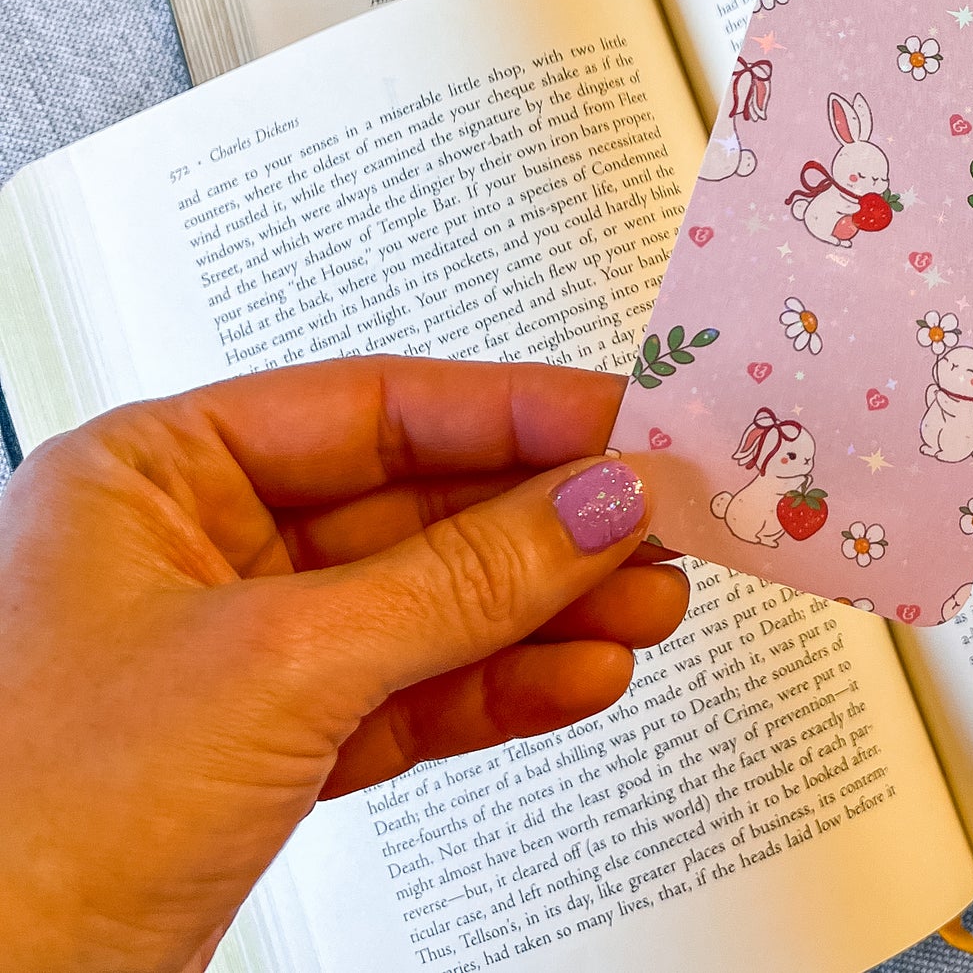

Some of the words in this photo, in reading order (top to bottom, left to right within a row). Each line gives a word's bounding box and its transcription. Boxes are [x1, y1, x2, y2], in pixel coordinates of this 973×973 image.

[169, 165, 191, 185] 572
[209, 136, 252, 163] Charles
[254, 116, 300, 145] Dickens
[177, 188, 201, 212] and
[207, 177, 240, 199] came
[244, 168, 259, 182] to
[264, 153, 293, 179] your
[297, 134, 340, 159] senses
[344, 125, 359, 140] in
[365, 120, 373, 131] a
[379, 90, 443, 125] miserable
[447, 76, 482, 98] little
[487, 65, 526, 84] shop,
[531, 48, 564, 68] with
[570, 43, 596, 59] two
[599, 33, 632, 52] little
[184, 199, 241, 230] counters,
[243, 180, 284, 203] where
[287, 168, 309, 185] the
[313, 150, 352, 174] oldest
[355, 137, 369, 156] of
[373, 130, 403, 149] men
[407, 110, 445, 136] made
[449, 98, 481, 124] your
[487, 81, 537, 105] cheque
[541, 65, 581, 89] shake
[584, 63, 598, 75] as
[601, 54, 611, 71] if
[615, 52, 635, 68] the
[192, 237, 255, 268] windows,
[257, 214, 297, 241] which
[300, 203, 332, 223] were
[335, 183, 378, 210] always
[381, 165, 420, 189] under
[425, 161, 434, 172] a
[437, 124, 524, 168] shower-bath
[528, 114, 543, 134] of
[547, 105, 580, 128] mud
[582, 99, 616, 117] from
[617, 91, 649, 107] Fleet
[366, 790, 410, 815] holder
[415, 777, 429, 797] of
[433, 780, 442, 791] a
[441, 764, 484, 787] horse
[486, 756, 502, 771] at
[501, 732, 563, 763] Tellson's
[566, 719, 604, 740] door,
[606, 704, 639, 724] who
[643, 684, 684, 710] made
[687, 669, 709, 692] off
[711, 657, 746, 682] with
[748, 651, 769, 666] it,
[768, 638, 796, 656] was
[797, 625, 821, 649] put
[823, 618, 838, 632] to
[395, 876, 436, 901] might
[438, 860, 484, 886] almost
[483, 848, 519, 868] have
[518, 835, 554, 854] been
[556, 813, 600, 841] worth
[602, 787, 678, 824] remarking
[678, 773, 708, 794] that
[711, 762, 738, 780] the
[738, 748, 769, 769] fact
[769, 735, 798, 754] was
[800, 710, 851, 741] exactly
[846, 701, 866, 718] the
[414, 944, 457, 965] Thus,
[458, 917, 522, 949] Tellson's,
[524, 911, 540, 927] in
[543, 904, 562, 920] its
[566, 893, 595, 912] day,
[596, 880, 625, 900] like
[627, 860, 679, 894] greater
[681, 841, 727, 873] places
[730, 826, 746, 847] of
[748, 804, 816, 839] business,
[816, 792, 837, 809] its
[839, 766, 889, 797] contem-
